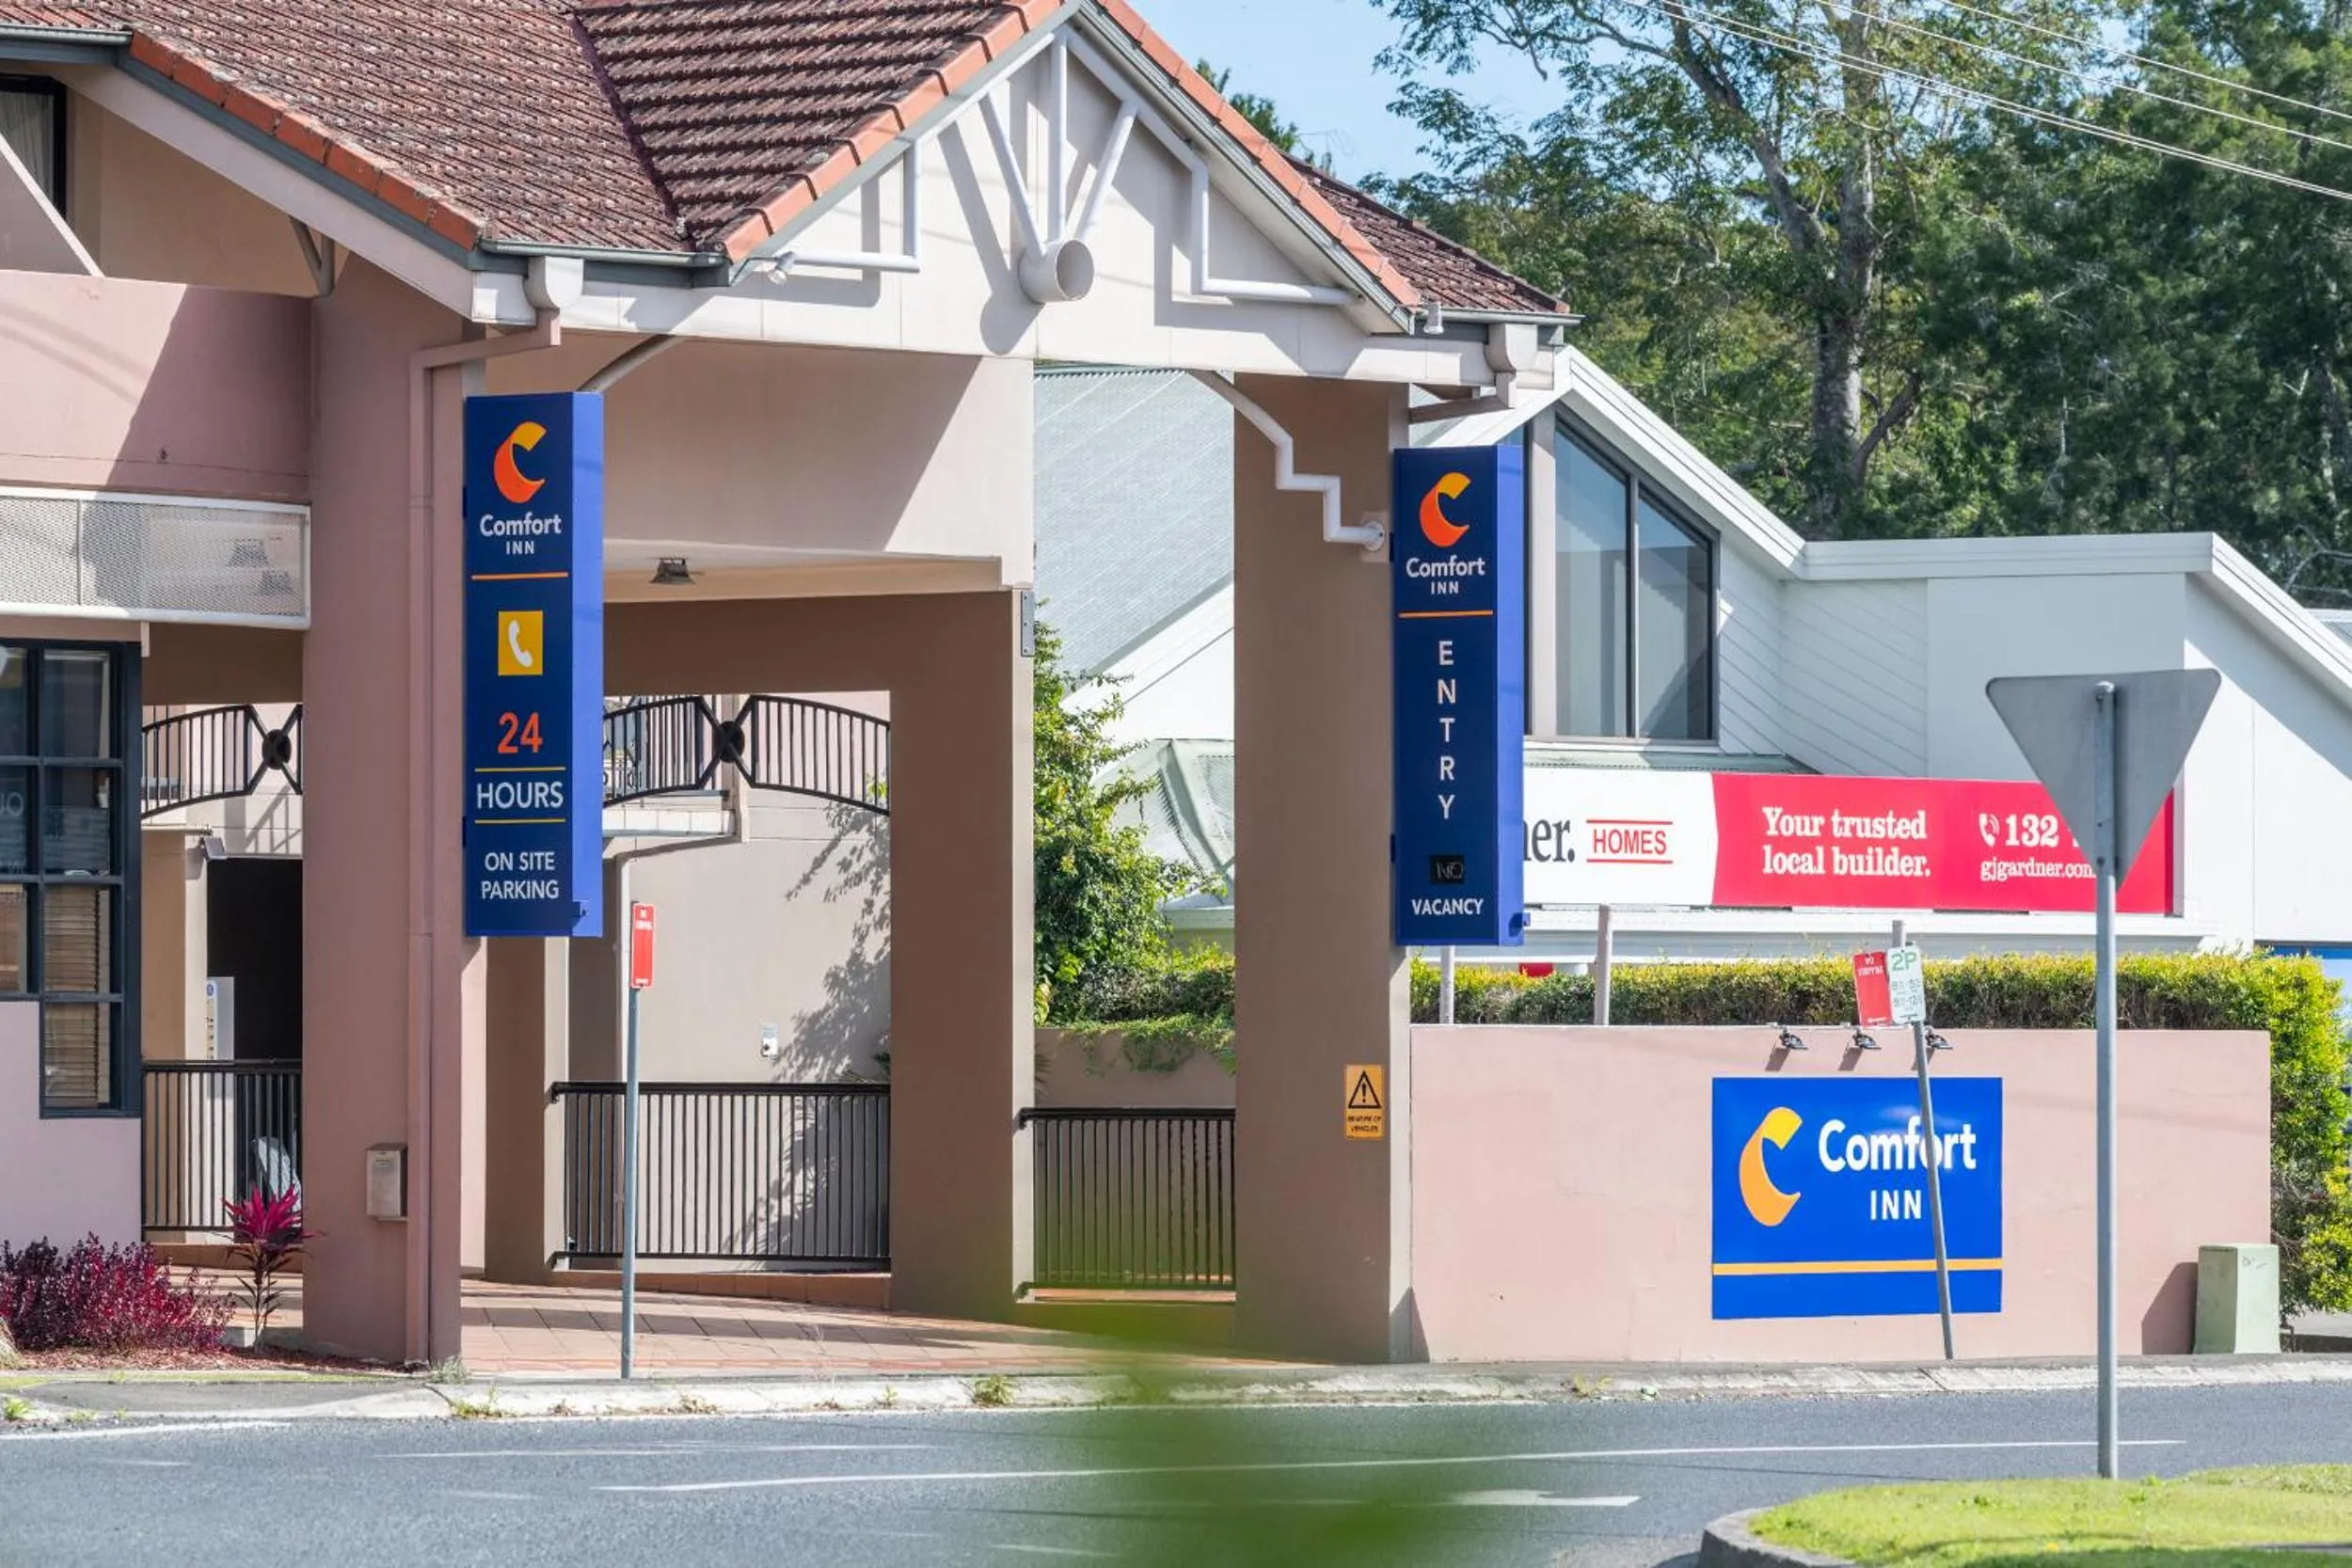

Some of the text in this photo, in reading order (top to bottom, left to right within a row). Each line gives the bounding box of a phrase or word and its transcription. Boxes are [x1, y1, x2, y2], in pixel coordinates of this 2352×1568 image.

[479, 511, 562, 537] Comfort
[506, 540, 535, 555] INN
[1406, 554, 1486, 578] Comfort
[1431, 580, 1459, 594] INN
[498, 711, 543, 753] 24
[1437, 640, 1457, 820] ENTRY
[476, 781, 564, 810] HOURS
[1761, 806, 1928, 839] Your trusted
[2005, 813, 2059, 847] 132
[1592, 828, 1667, 856] HOMES
[484, 850, 556, 871] ON SITE
[1762, 845, 1931, 878] local builder.
[481, 879, 560, 900] PARKING
[1411, 897, 1485, 916] VACANCY
[1891, 951, 1917, 972] 2P
[1818, 1116, 1977, 1173] Comfort
[1869, 1189, 1922, 1221] INN
